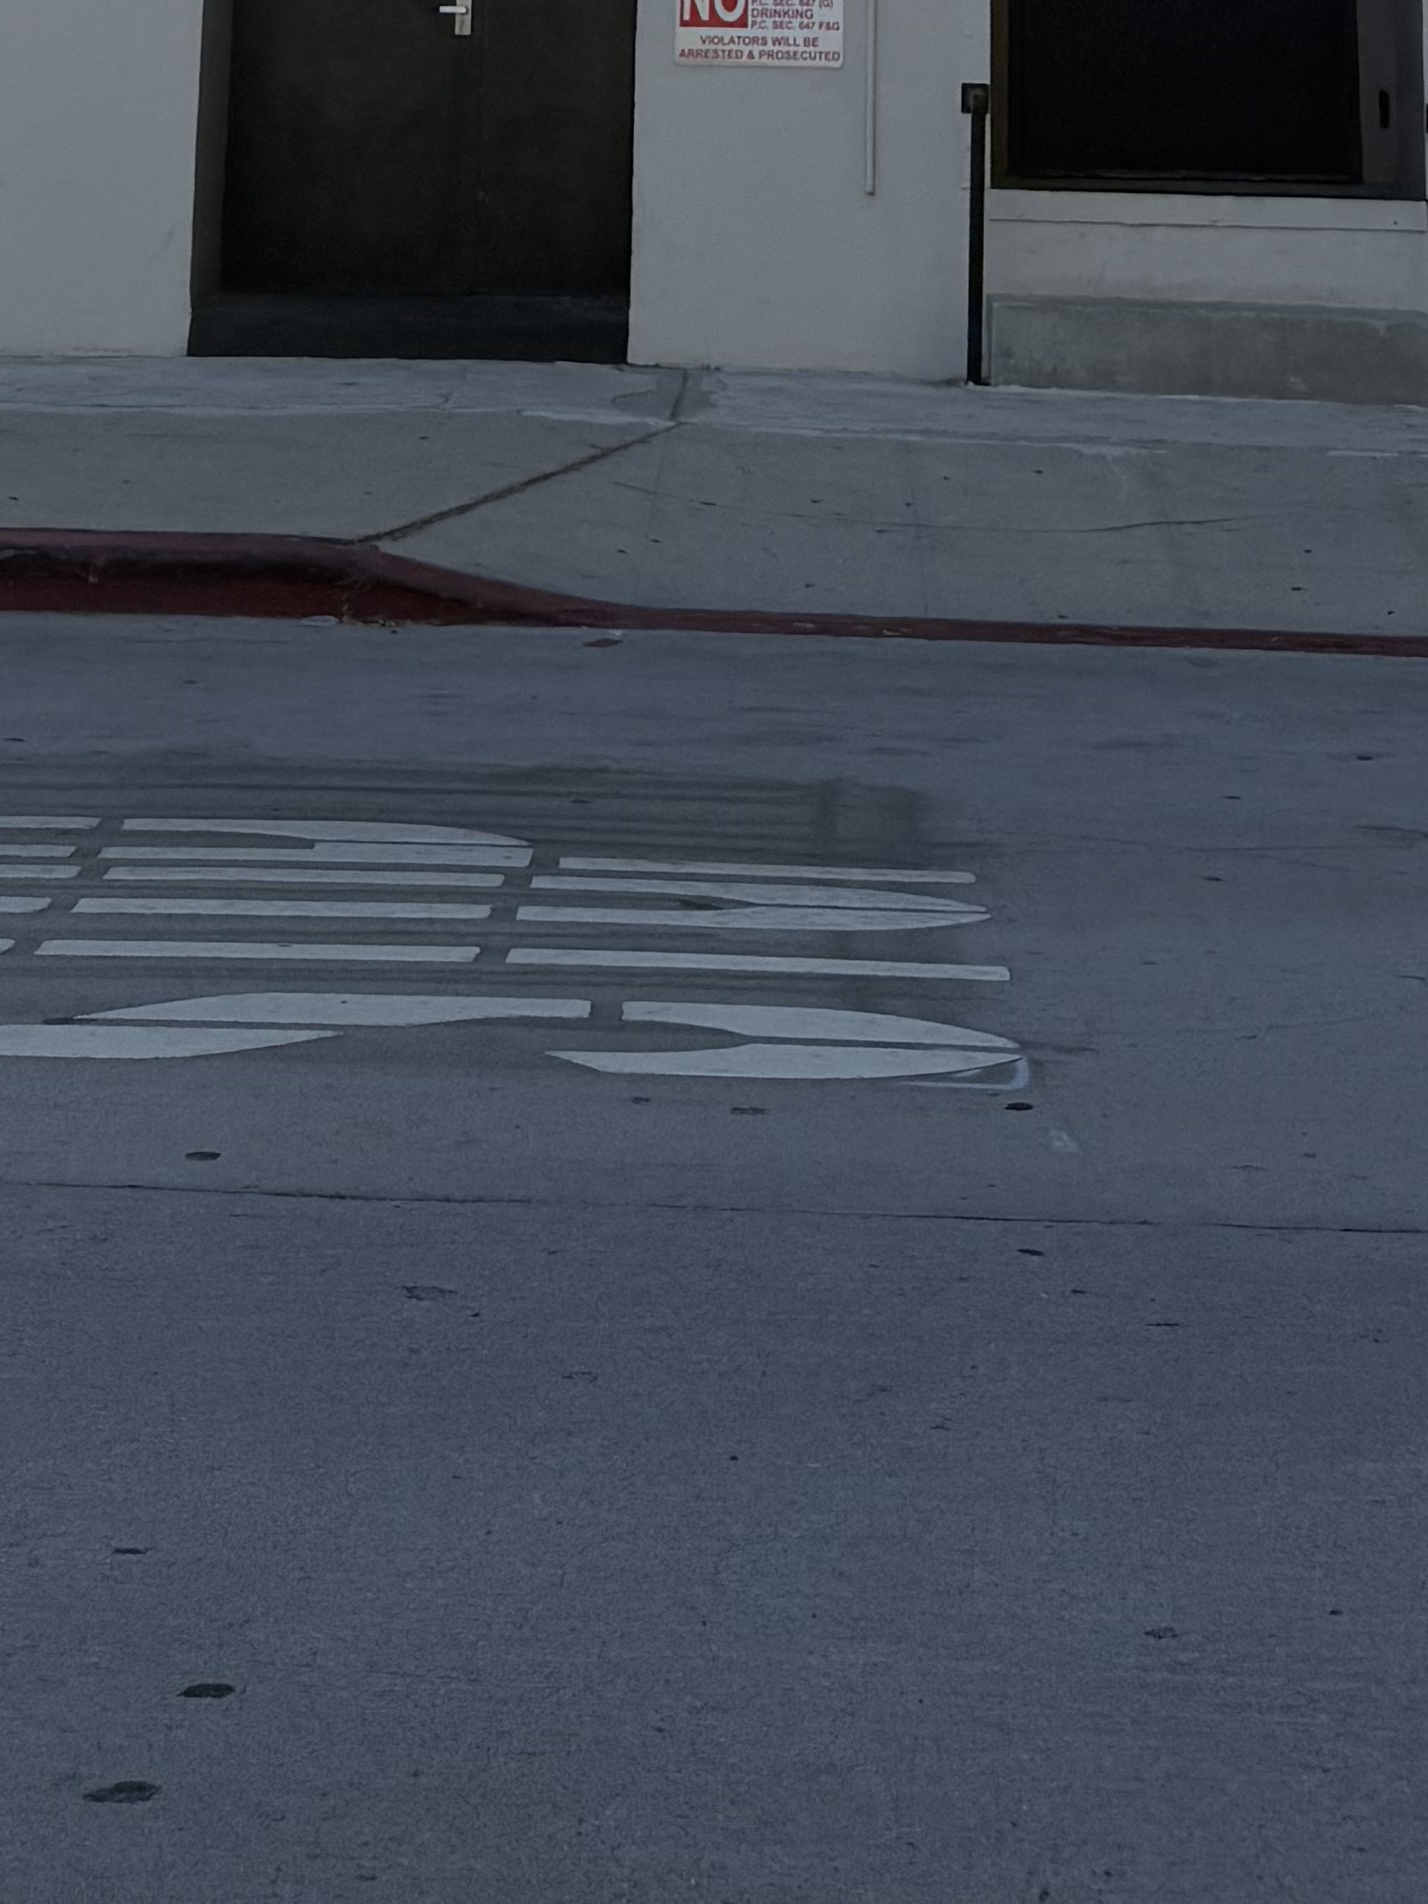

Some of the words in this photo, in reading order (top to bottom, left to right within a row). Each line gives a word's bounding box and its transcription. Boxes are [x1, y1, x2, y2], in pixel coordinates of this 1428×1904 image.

[751, 8, 814, 20] DRINKING
[700, 35, 768, 47] VIOLATORS
[771, 36, 800, 48] WILL
[803, 37, 820, 48] BE
[678, 47, 744, 60] ARRESTED
[746, 49, 756, 61] &
[759, 49, 841, 62] PROSECUTED
